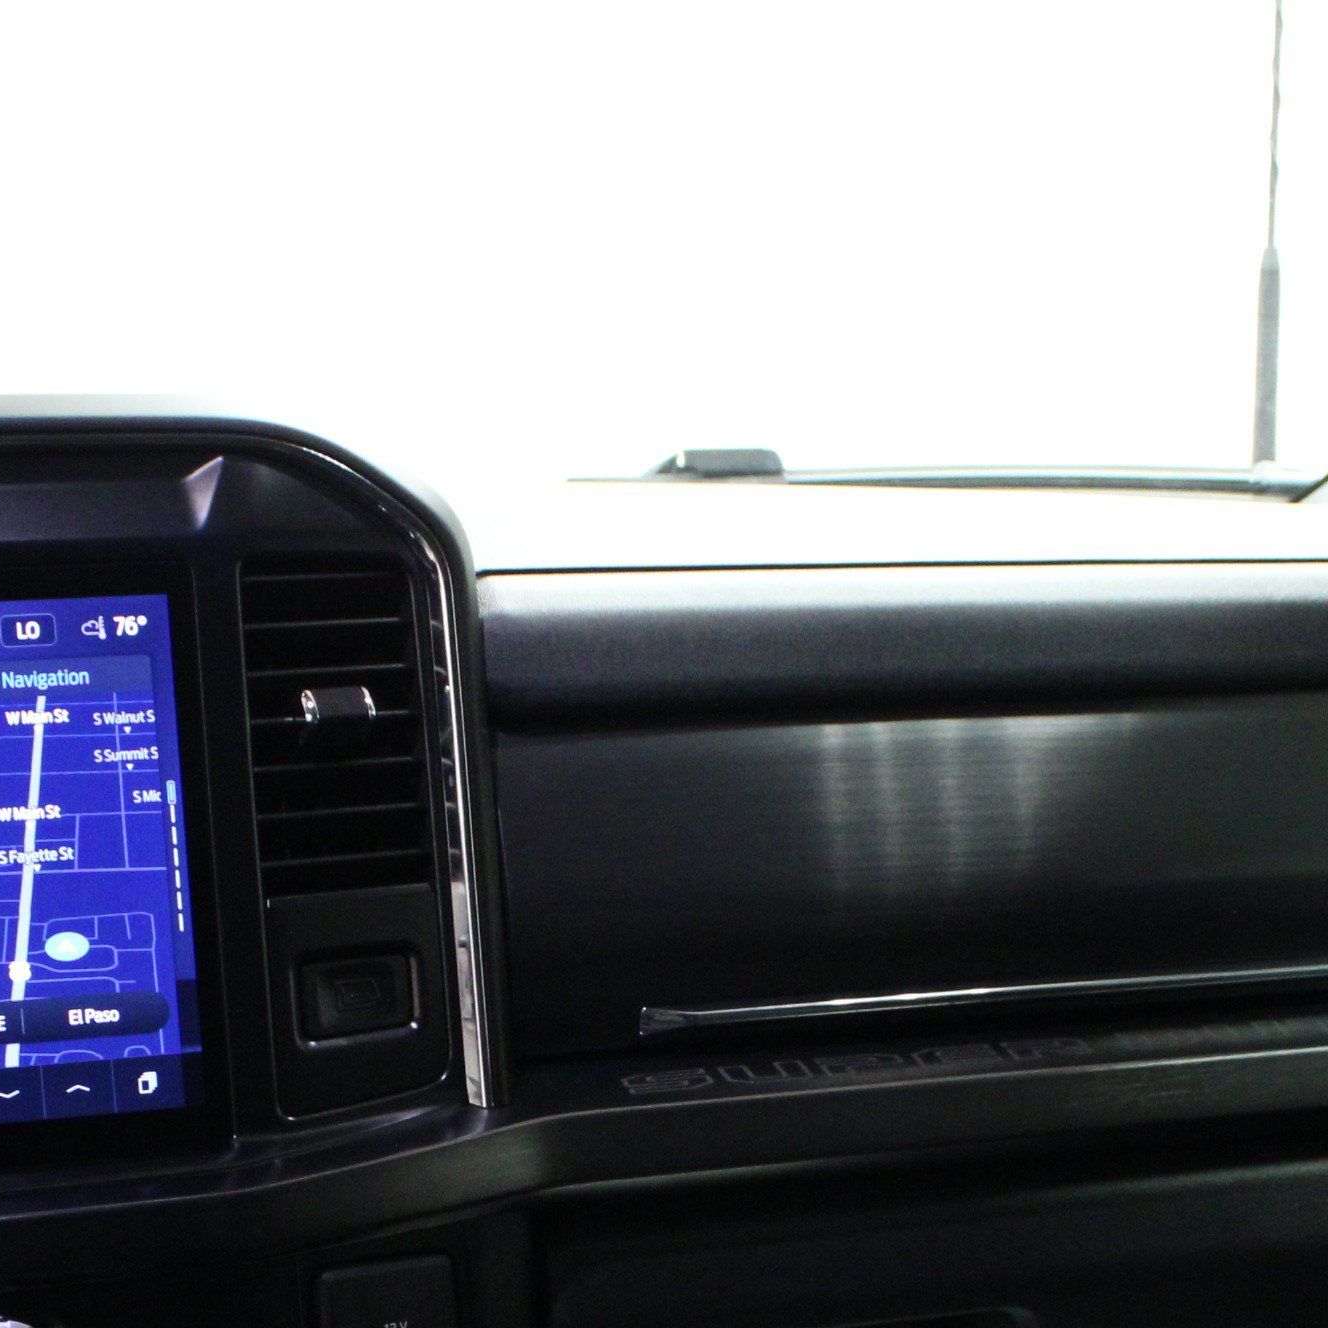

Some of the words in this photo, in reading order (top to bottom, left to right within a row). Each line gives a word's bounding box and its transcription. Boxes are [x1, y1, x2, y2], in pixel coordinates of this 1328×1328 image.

[15, 621, 41, 640] LO
[1, 668, 90, 691] Navigation
[4, 711, 21, 726] W
[53, 708, 70, 723] St
[92, 712, 102, 726] S
[102, 711, 145, 725] Walnut
[93, 749, 103, 763] S
[104, 747, 149, 762] Summit
[132, 790, 141, 803] S
[45, 804, 61, 819] St
[9, 847, 58, 864] Fayette
[58, 846, 74, 861] St
[68, 1009, 83, 1025] El
[85, 1007, 120, 1025] Paso
